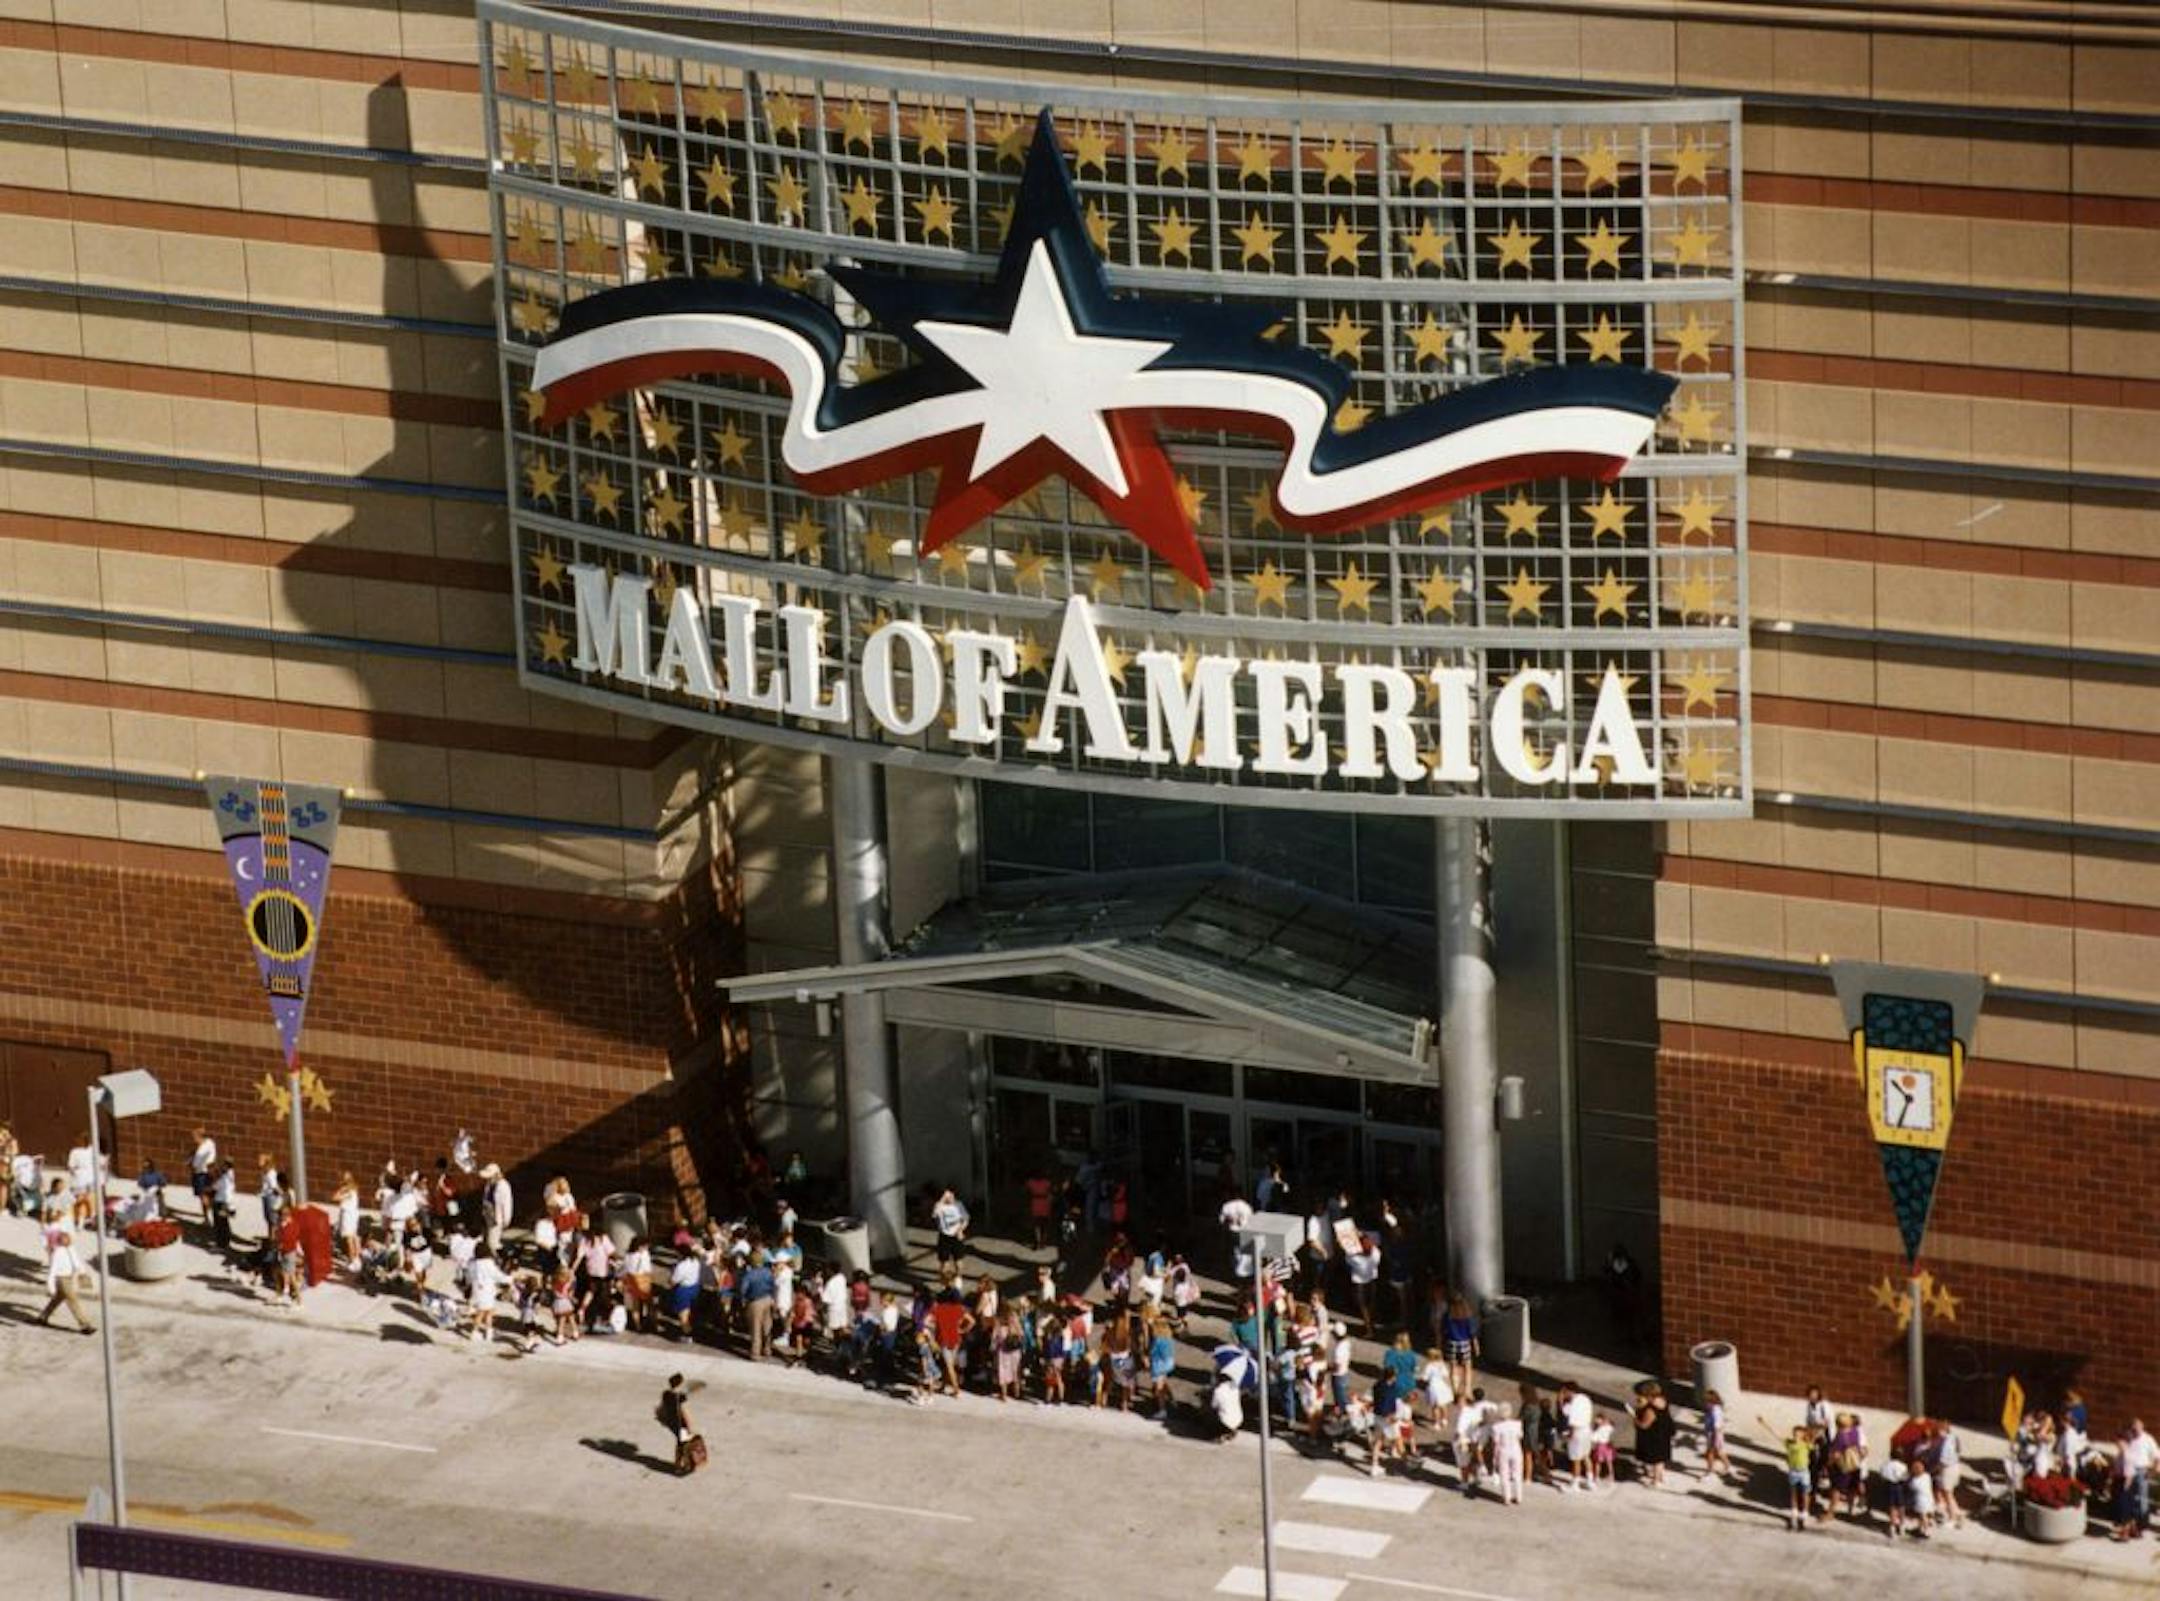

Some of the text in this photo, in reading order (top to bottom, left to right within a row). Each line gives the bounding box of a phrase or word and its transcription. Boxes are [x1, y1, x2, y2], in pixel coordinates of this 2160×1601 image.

[568, 565, 1660, 785] MALL OF AMERICA
